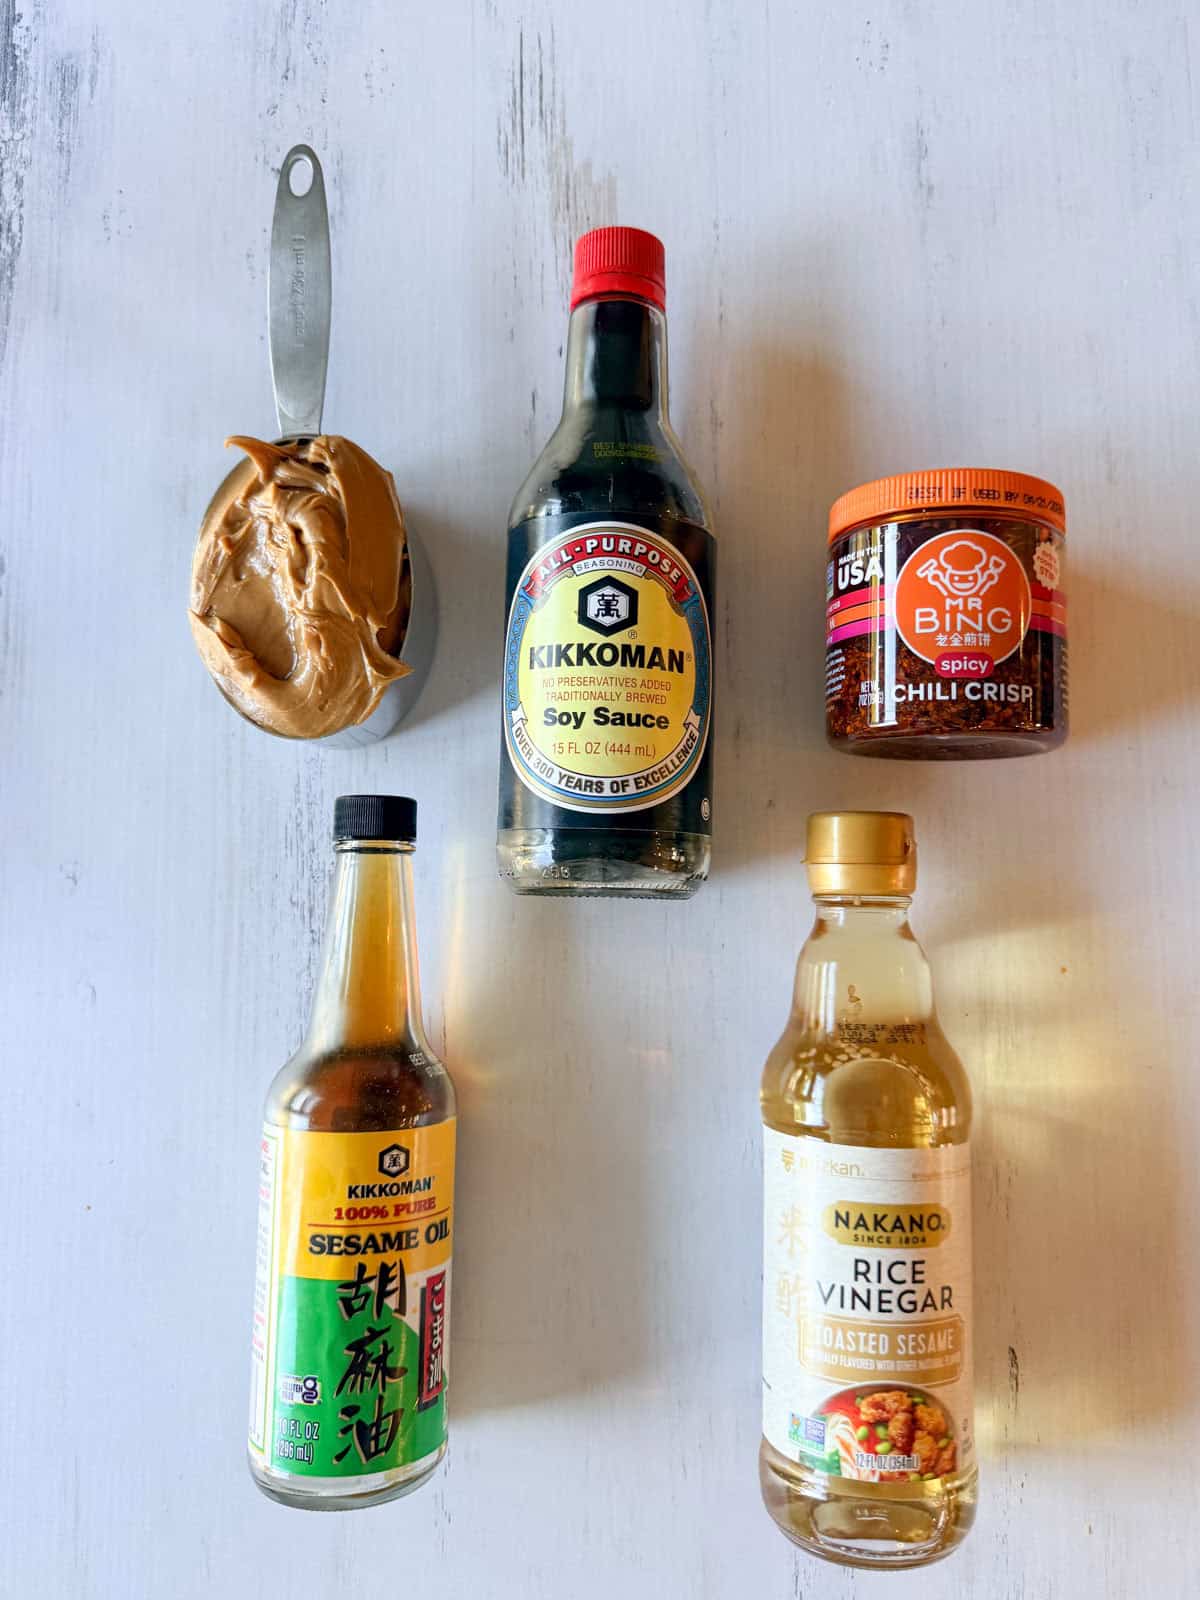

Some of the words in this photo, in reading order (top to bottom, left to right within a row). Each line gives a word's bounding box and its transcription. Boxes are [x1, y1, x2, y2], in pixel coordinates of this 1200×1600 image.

[908, 487, 943, 499] BEST
[952, 487, 966, 498] IF
[974, 488, 1000, 500] USED
[1004, 490, 1018, 501] BY
[540, 537, 682, 583] ALL-PURPOSE
[576, 559, 644, 574] SEASONING
[838, 551, 856, 567] MADE
[838, 557, 884, 590] USA
[945, 597, 982, 611] MR
[915, 607, 1012, 634] BING
[529, 642, 686, 673] KIKKOMAN
[941, 656, 989, 673] spicy
[543, 677, 555, 688] NO
[557, 676, 637, 688] PRESERVATIVES
[640, 679, 672, 691] ADDED
[893, 682, 957, 702] CHILI
[965, 682, 1033, 703] CRISP
[546, 690, 622, 702] TRADITIONALLY
[626, 692, 667, 704] BREWED
[543, 707, 586, 729] Soy
[593, 706, 669, 729] Sauce
[515, 726, 532, 762] OVER
[533, 758, 554, 780] 300
[557, 772, 606, 794] YEARS
[610, 783, 631, 794] OF
[635, 731, 697, 790] EXCELLENCE
[552, 743, 564, 754] 15
[568, 742, 580, 754] FL
[585, 742, 600, 755] OZ
[604, 741, 631, 757] (444
[634, 742, 656, 759] mL)
[348, 1176, 432, 1199] KIKKOMAN
[334, 1204, 389, 1220] 100%
[393, 1196, 437, 1217] PURE
[834, 1209, 942, 1233] NAKANO
[309, 1227, 420, 1256] SESAME
[425, 1217, 450, 1245] OIL
[853, 1234, 891, 1244] SINCE
[899, 1235, 927, 1245] 1804
[854, 1258, 926, 1284] RICE
[816, 1279, 953, 1314] VINEGAR
[896, 1328, 954, 1356] SESAME
[290, 1419, 302, 1439] FL
[305, 1421, 320, 1440] OZ
[855, 1453, 865, 1467] 12
[866, 1454, 875, 1469] FL
[877, 1455, 888, 1470] OZ
